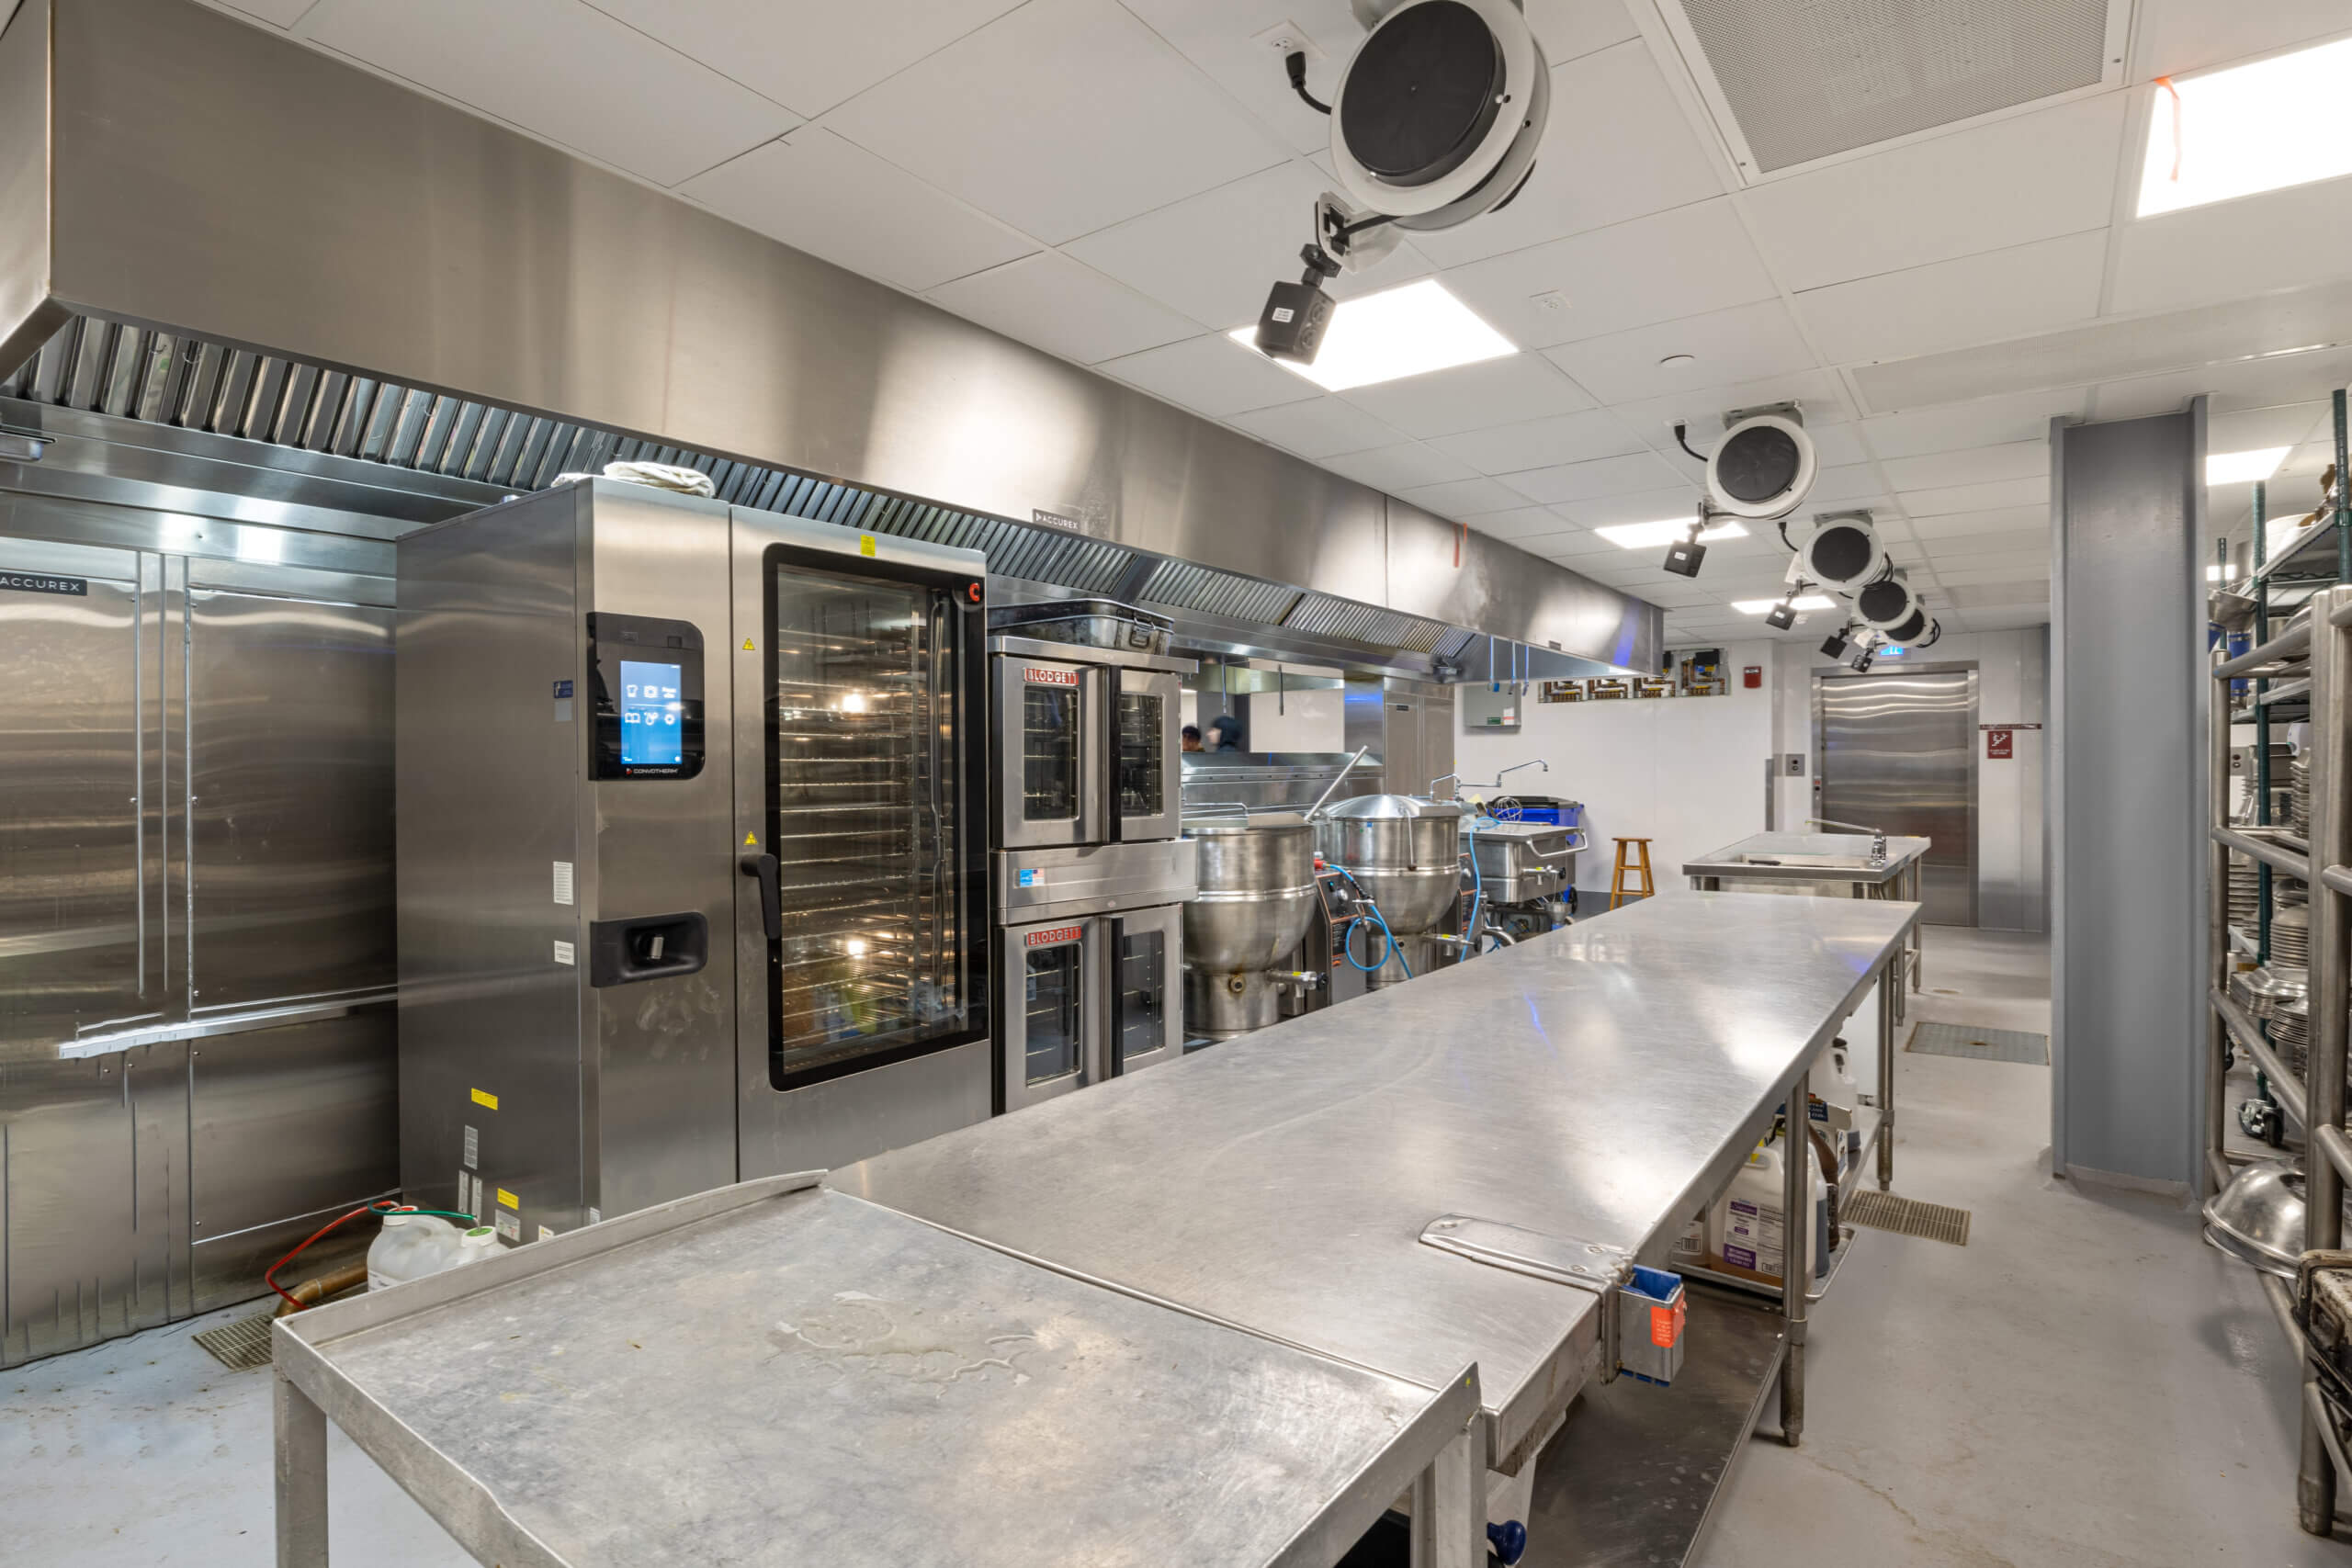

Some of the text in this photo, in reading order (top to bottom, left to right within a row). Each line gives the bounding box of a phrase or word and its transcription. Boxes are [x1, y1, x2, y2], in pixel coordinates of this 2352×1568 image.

[1043, 515, 1078, 529] ACCUREX
[0, 576, 80, 592] ACCUREX
[1028, 670, 1080, 684] BLODGETT
[1030, 928, 1080, 944] BLODGETT
